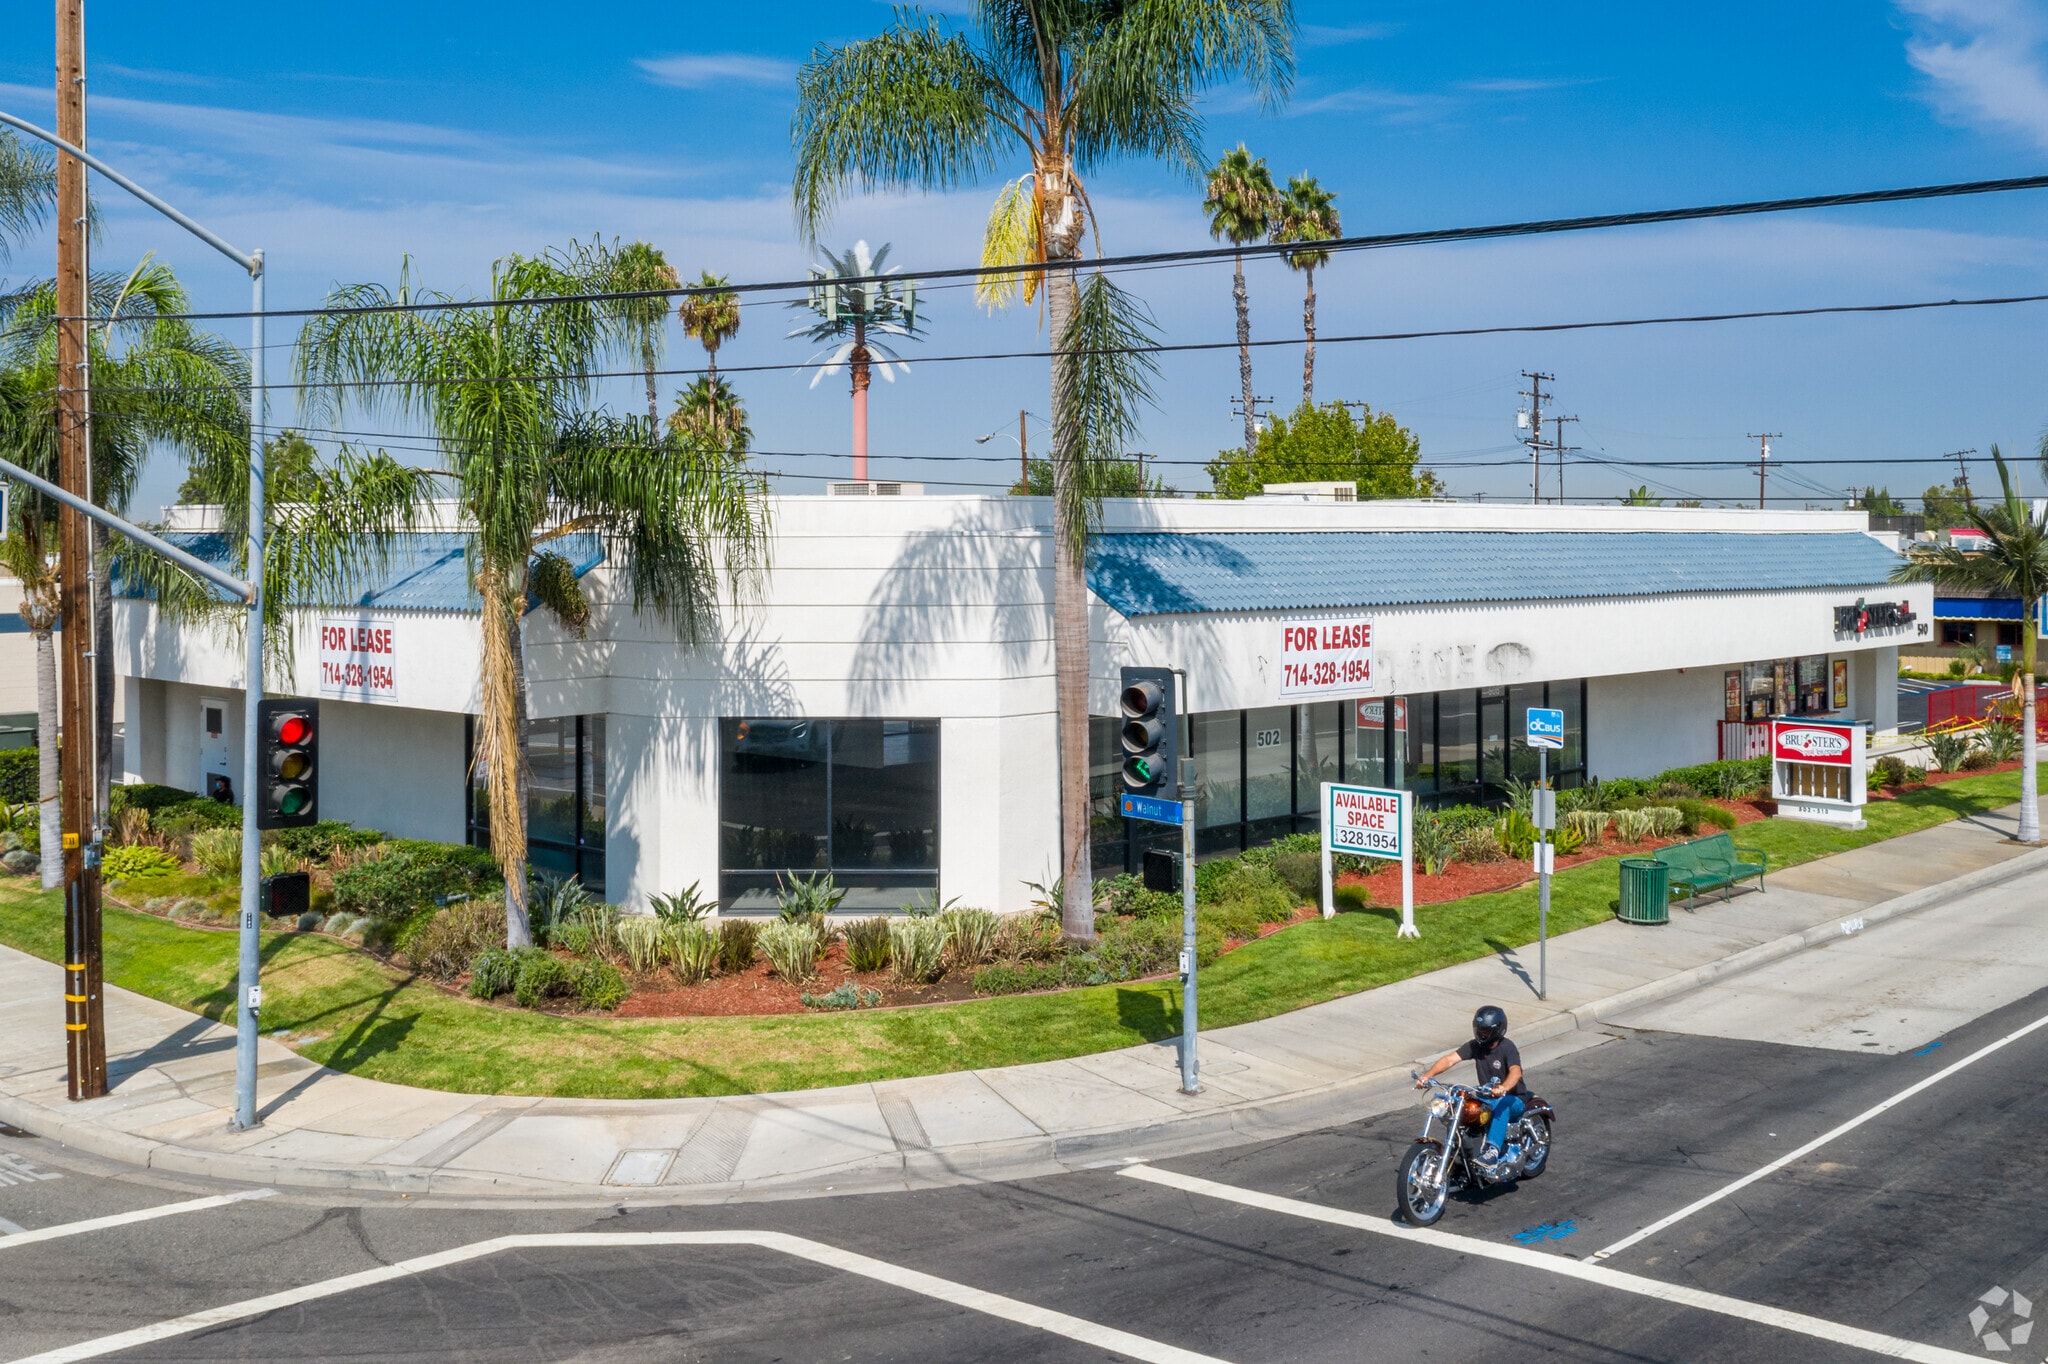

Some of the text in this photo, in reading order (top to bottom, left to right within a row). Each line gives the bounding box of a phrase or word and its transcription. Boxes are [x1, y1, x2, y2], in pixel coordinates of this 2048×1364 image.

[1284, 624, 1371, 652] FOR LEASE
[1917, 622, 1929, 636] 510
[322, 626, 392, 654] FOR LEASE
[322, 661, 393, 689] 714-328-1954
[1284, 658, 1370, 687] 714-328-1954
[1257, 730, 1280, 747] 502
[1785, 735, 1842, 749] BRUSTER'S
[1136, 801, 1162, 816] Walnut
[1335, 792, 1397, 814] AVAILABLE
[1347, 811, 1385, 830] SPACE
[1340, 829, 1398, 850] 328.1954
